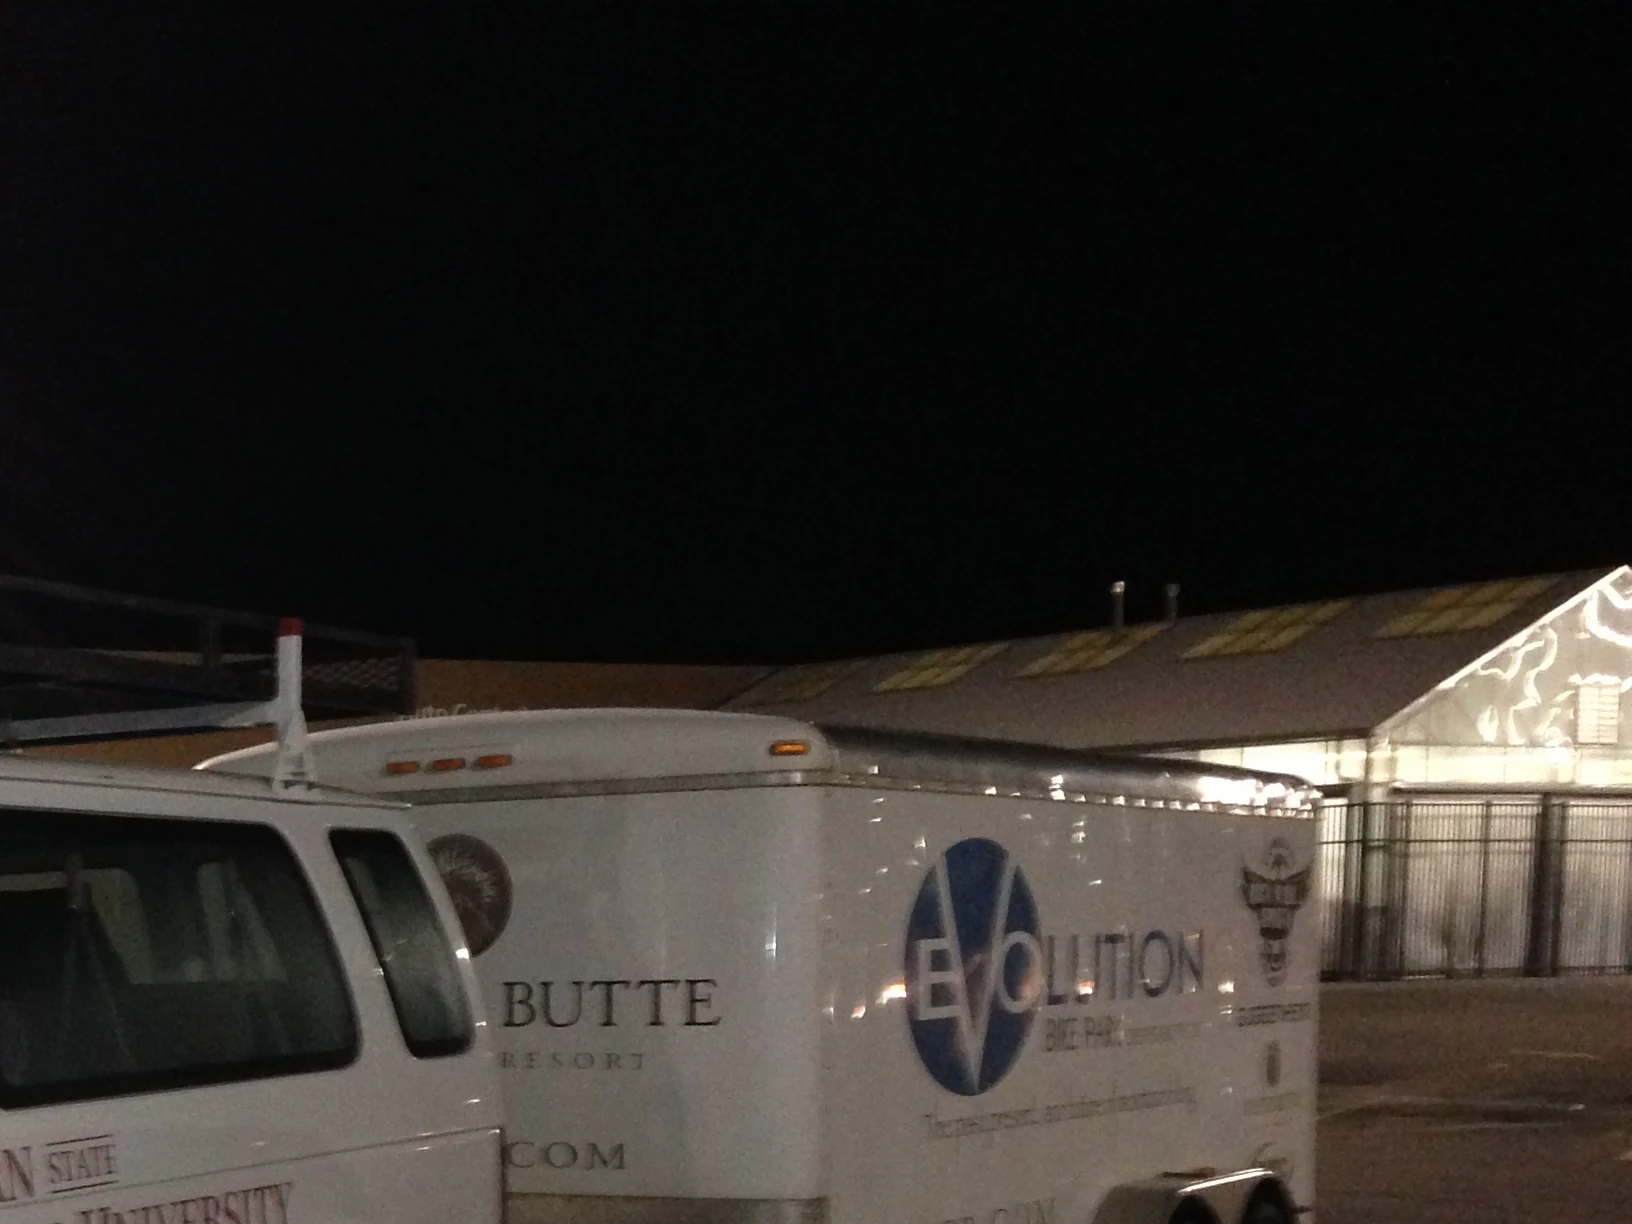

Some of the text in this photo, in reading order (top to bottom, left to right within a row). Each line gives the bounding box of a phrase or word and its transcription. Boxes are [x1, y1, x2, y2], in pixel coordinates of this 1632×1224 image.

[501, 978, 723, 1028] BUTTE
[500, 1051, 644, 1070] RESORT
[47, 1143, 118, 1184] STATE
